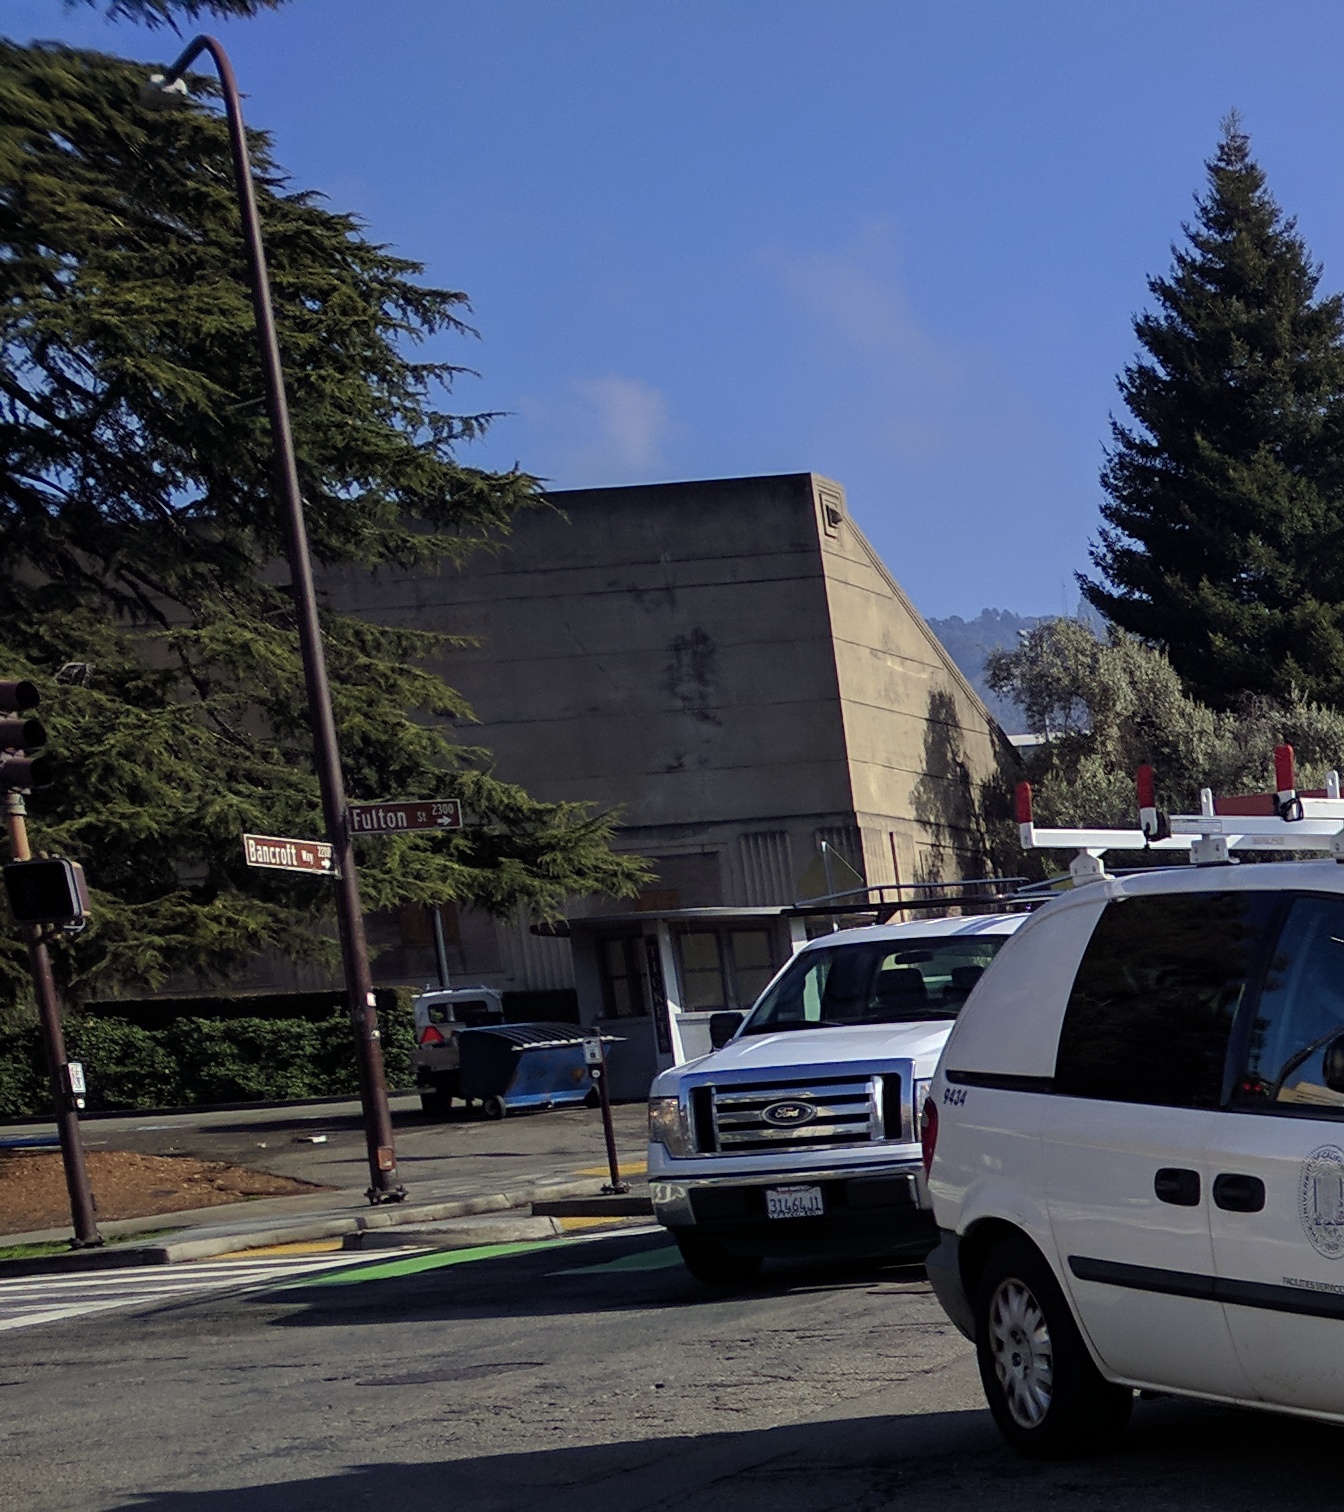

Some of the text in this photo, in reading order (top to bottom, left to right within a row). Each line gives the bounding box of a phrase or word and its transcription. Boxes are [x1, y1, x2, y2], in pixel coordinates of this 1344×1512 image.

[352, 803, 454, 830] Fulton St 2300
[248, 839, 298, 866] Bancroft
[300, 849, 314, 865] Way
[943, 1087, 968, 1106] 9434
[774, 1106, 800, 1118] Ford
